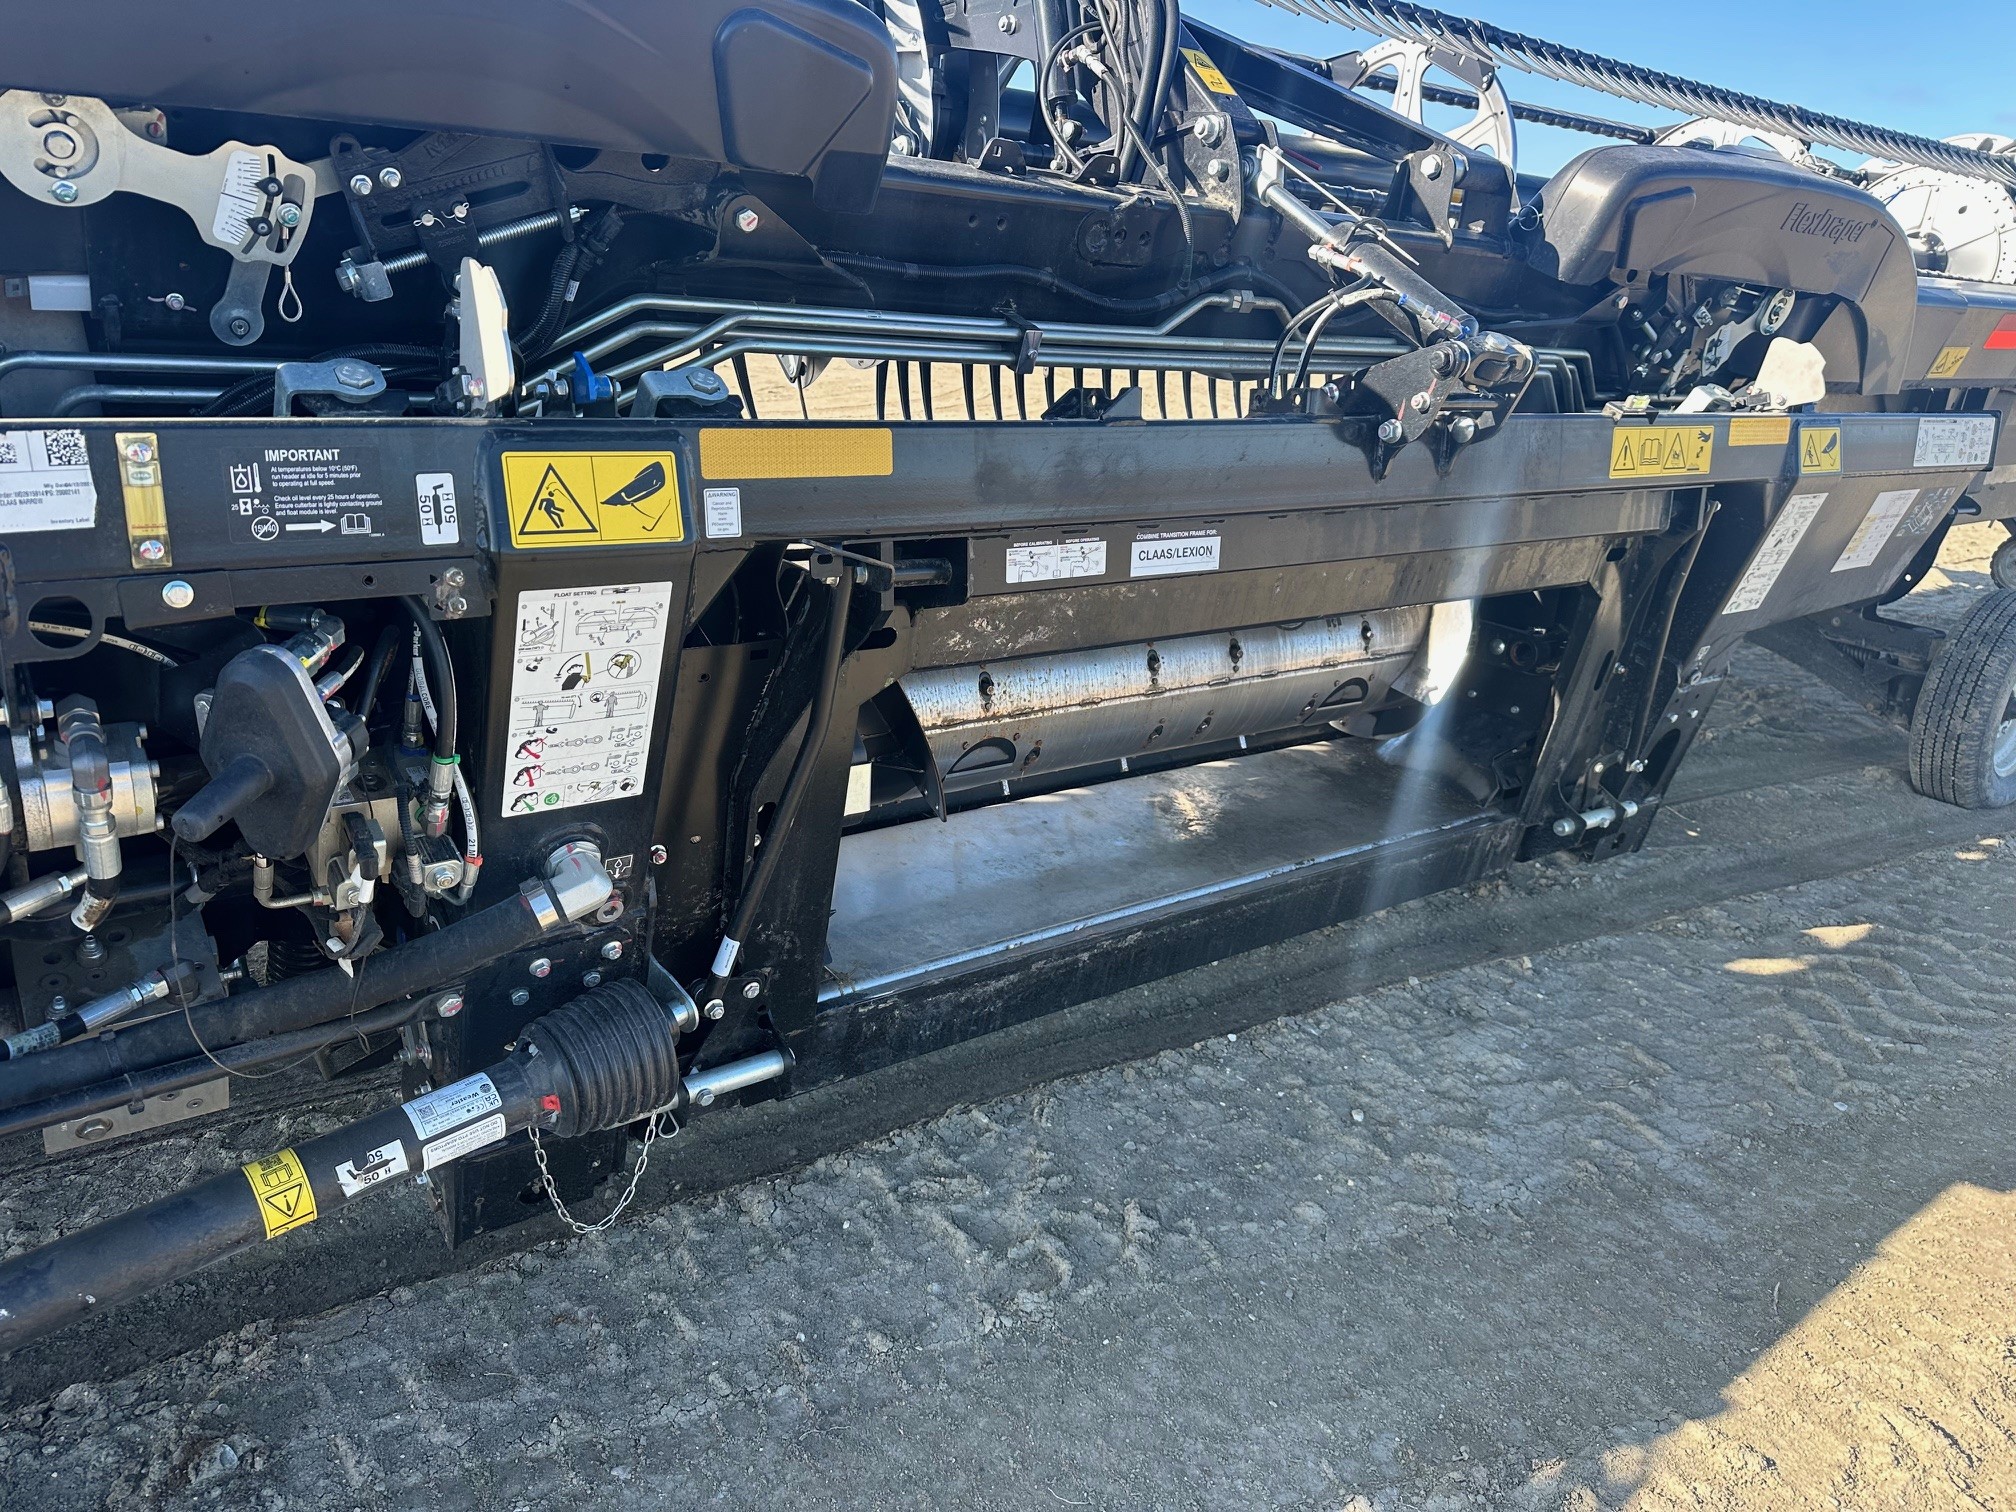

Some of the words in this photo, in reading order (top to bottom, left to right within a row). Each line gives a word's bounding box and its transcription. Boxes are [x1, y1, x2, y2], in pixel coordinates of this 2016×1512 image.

[264, 449, 340, 462] IMPORTANT
[350, 472, 361, 480] prior
[279, 480, 303, 488] operating
[318, 479, 336, 487] speed.
[356, 492, 381, 500] operation.
[231, 503, 239, 511] 25
[339, 500, 365, 508] contacting
[365, 500, 383, 508] ground
[419, 494, 432, 514] 50
[443, 505, 456, 524] 50
[1138, 545, 1213, 561] CLAAS/LEXION
[451, 1091, 479, 1106] Weasler
[479, 1123, 490, 1131] NOT
[489, 1119, 498, 1127] DO
[457, 1132, 469, 1140] PTO
[468, 1128, 479, 1136] USE
[367, 1150, 383, 1164] 50
[364, 1171, 379, 1185] 50
